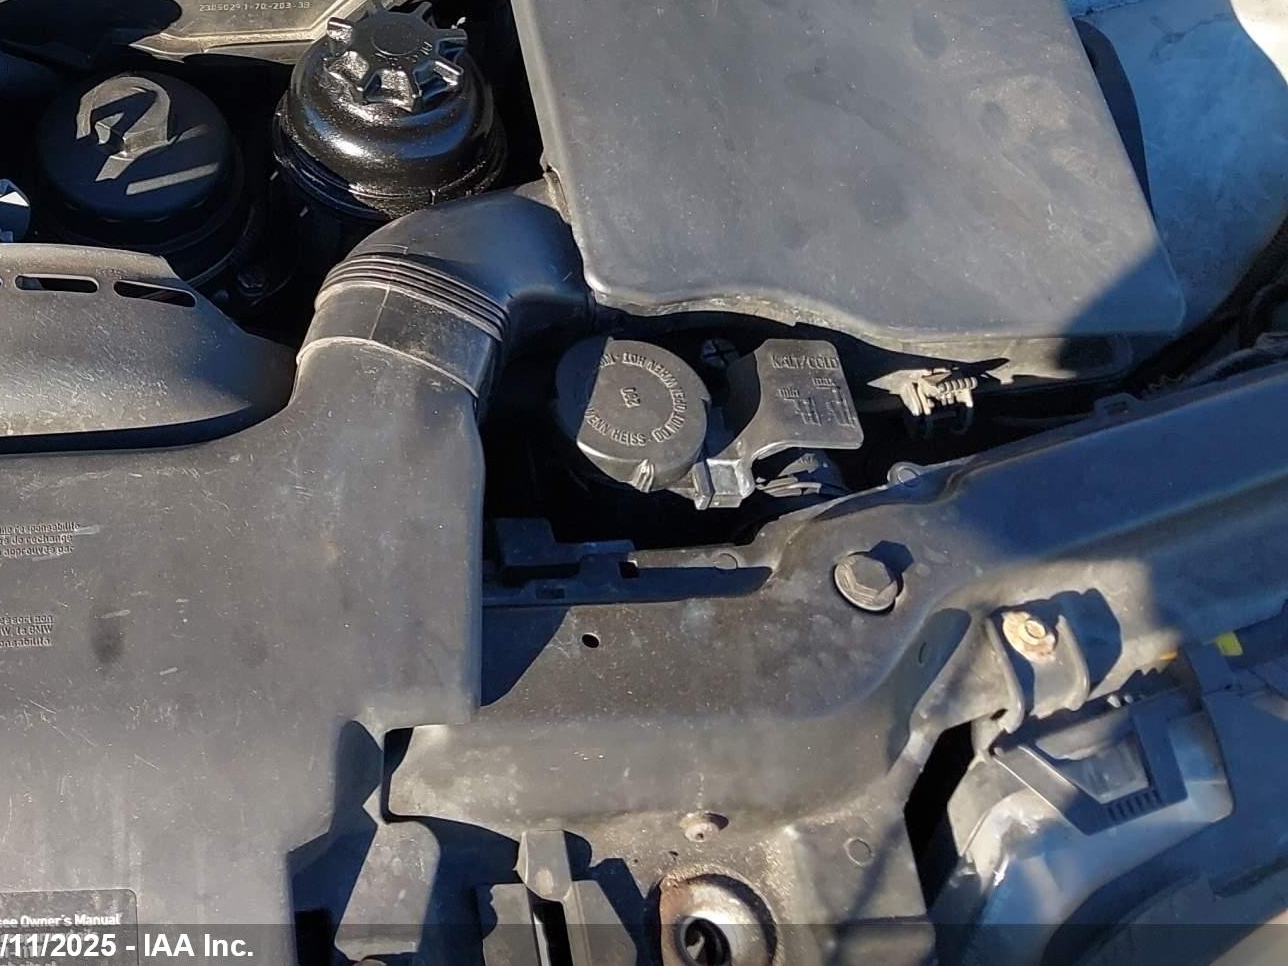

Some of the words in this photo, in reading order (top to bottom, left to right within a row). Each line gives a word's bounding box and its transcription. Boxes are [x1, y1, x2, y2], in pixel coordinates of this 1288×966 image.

[621, 352, 647, 368] HOT
[771, 354, 839, 370] KALT/COLD
[645, 359, 678, 389] WHEN
[611, 428, 647, 447] HEISS
[651, 425, 672, 443] DO
[25, 533, 73, 545] rechange
[28, 624, 53, 635] BMW
[20, 914, 73, 928] Owner's
[74, 913, 122, 927] Manual
